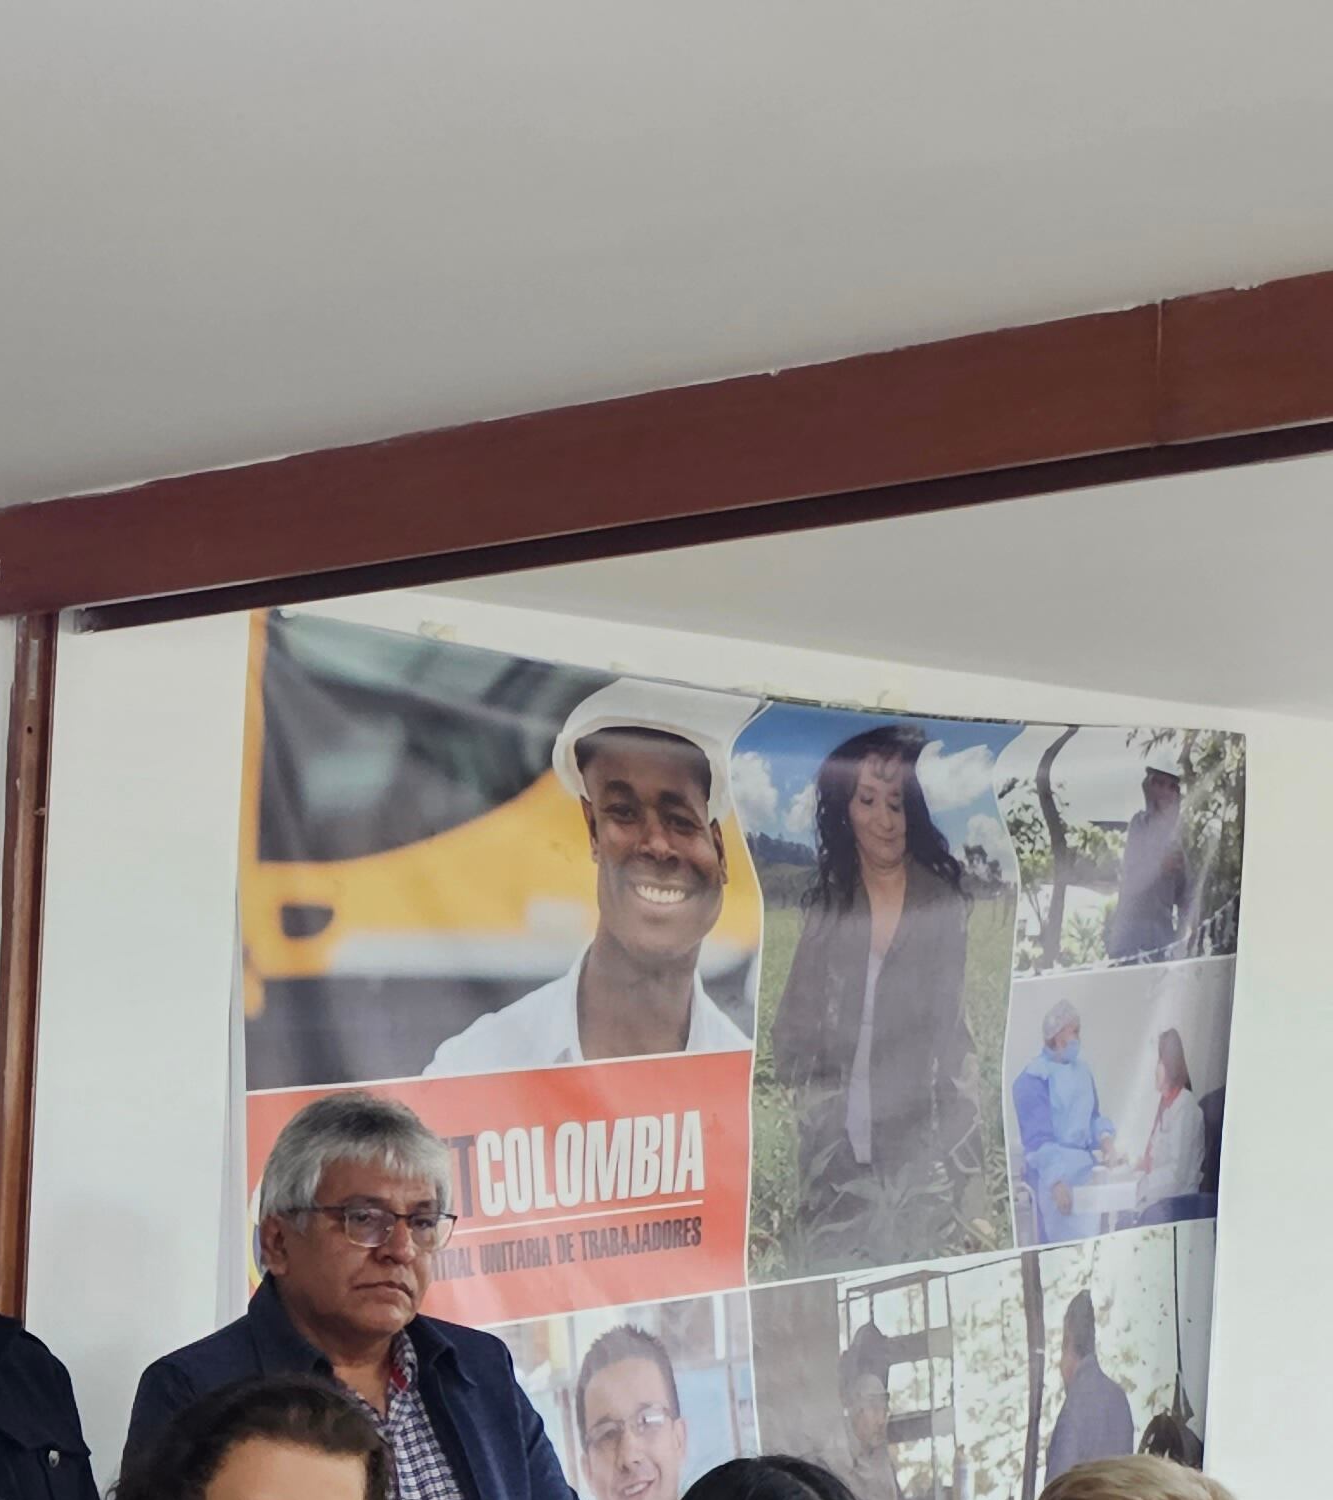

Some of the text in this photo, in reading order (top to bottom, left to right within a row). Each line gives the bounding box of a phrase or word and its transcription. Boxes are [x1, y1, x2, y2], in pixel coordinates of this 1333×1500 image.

[476, 1110, 705, 1217] COLOMBIA
[479, 1236, 552, 1275] UNITARIA
[556, 1233, 575, 1264] DE
[579, 1216, 702, 1261] TRABAJADORES
